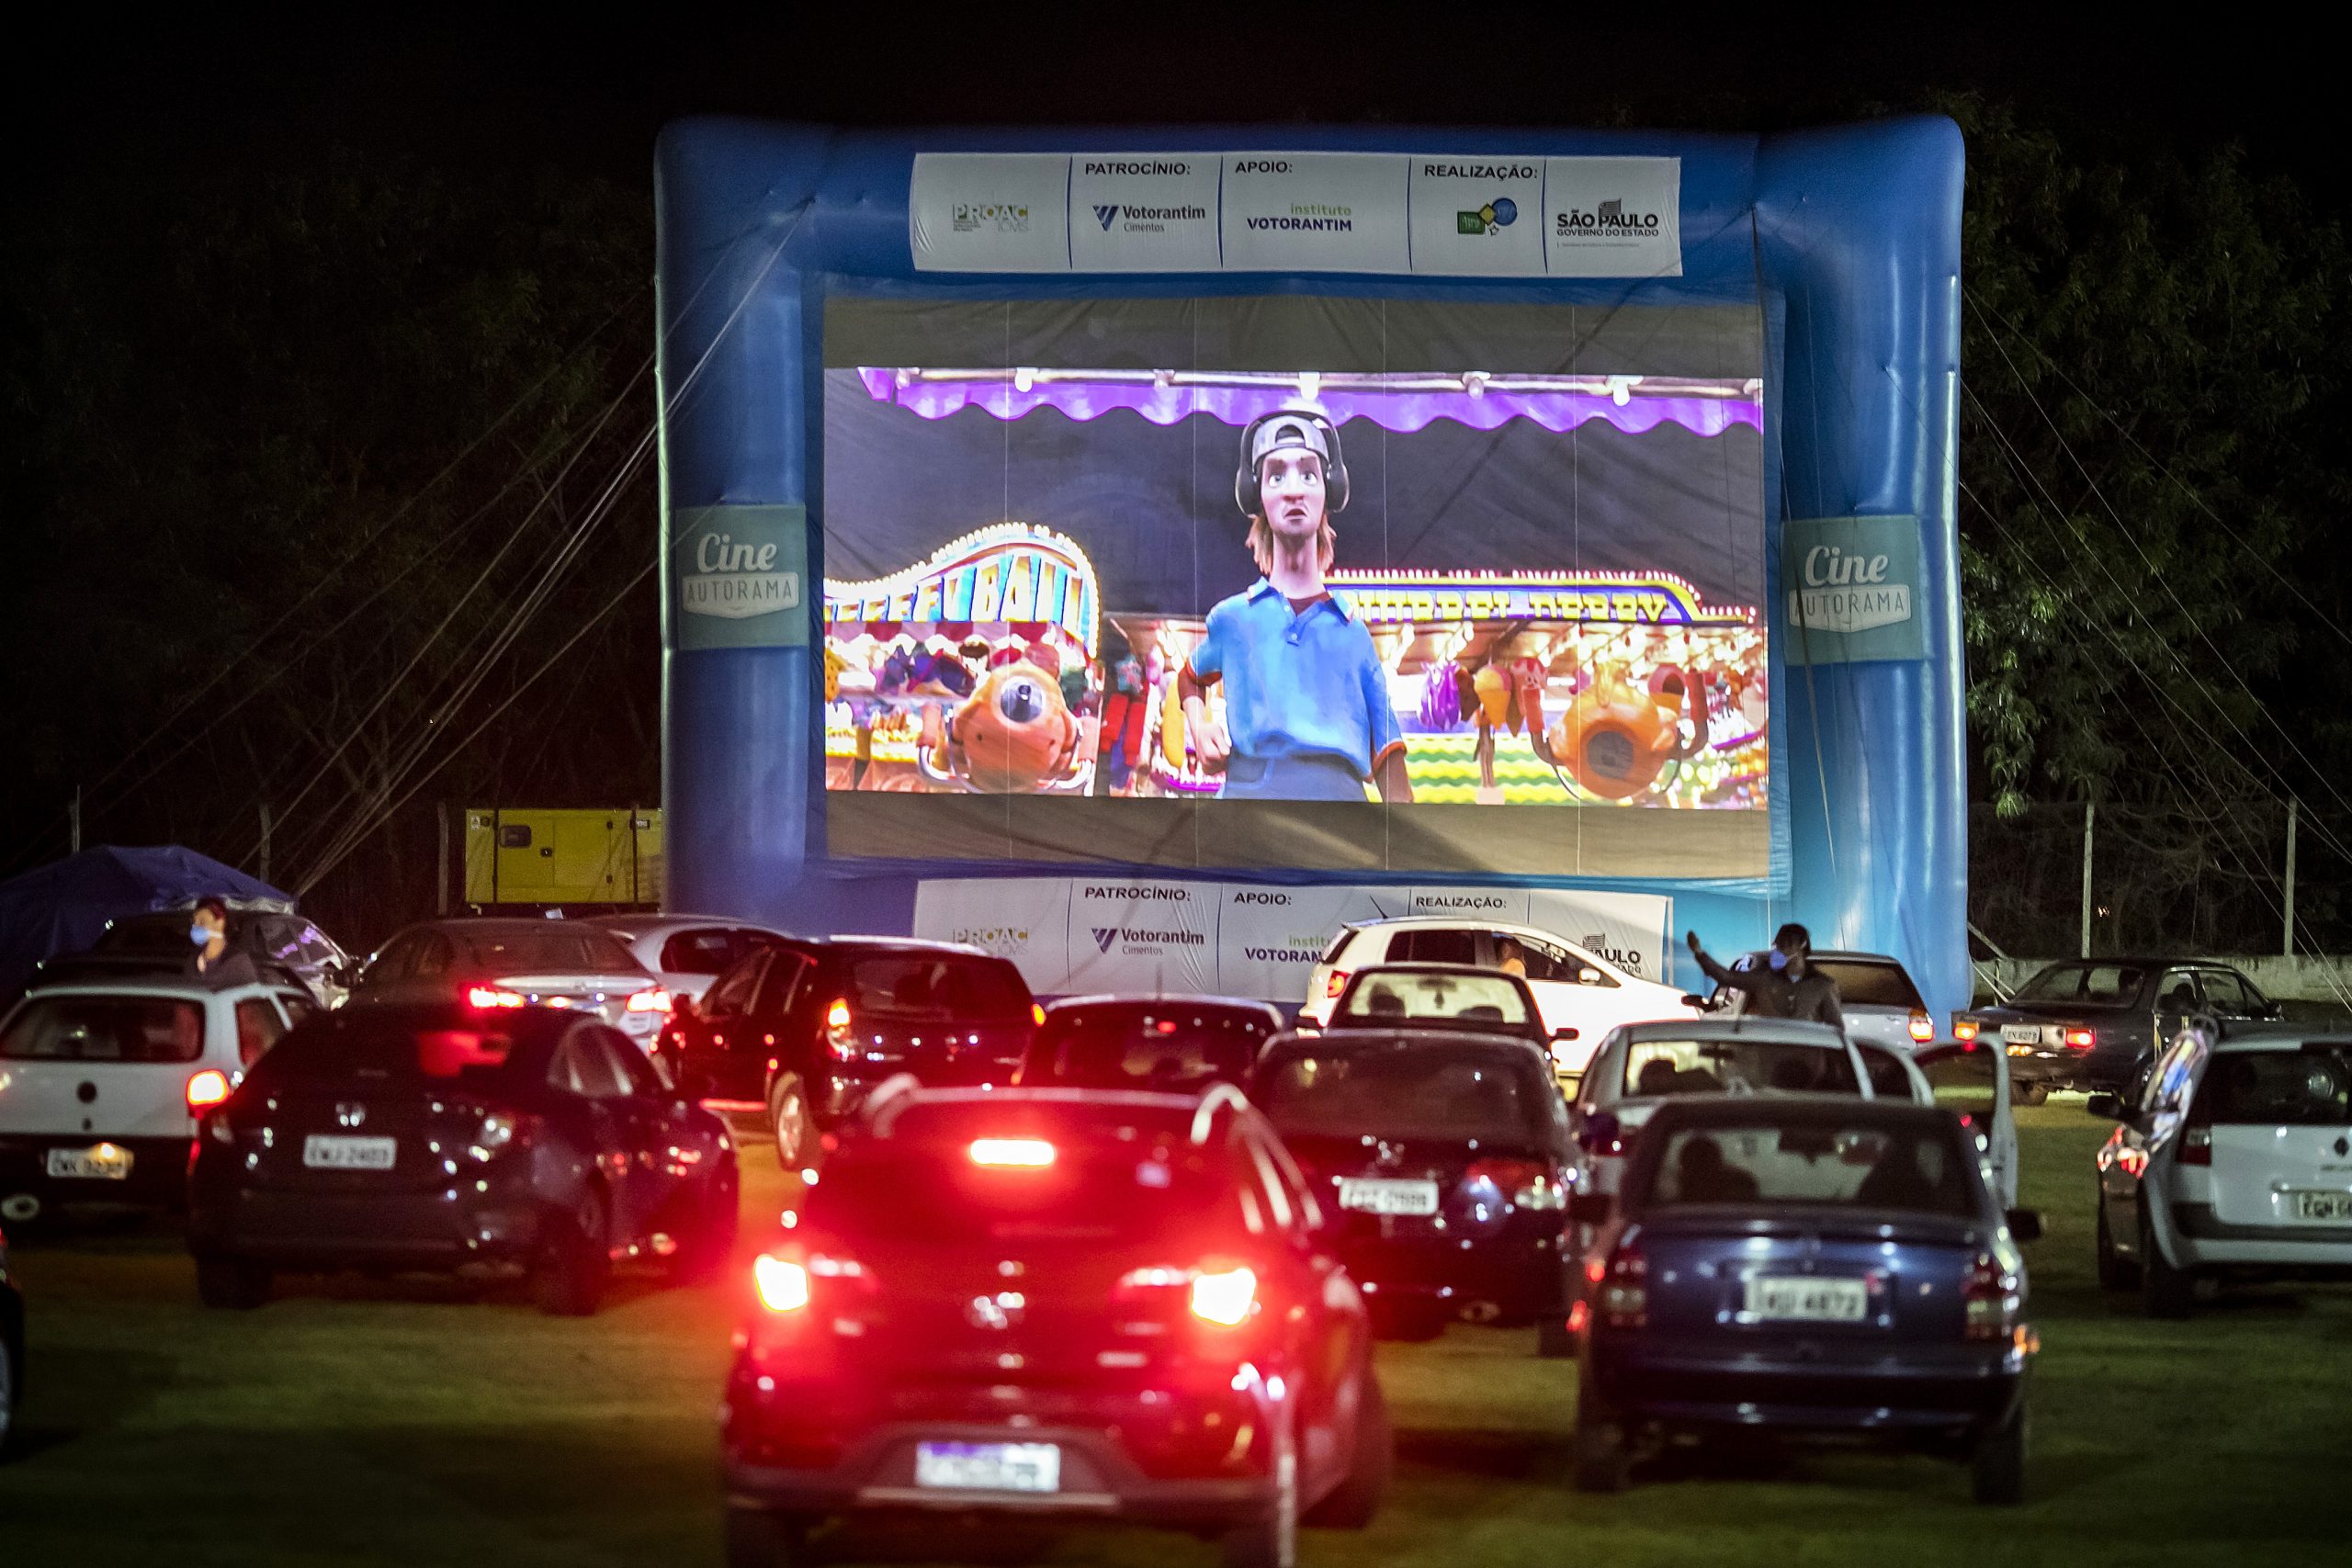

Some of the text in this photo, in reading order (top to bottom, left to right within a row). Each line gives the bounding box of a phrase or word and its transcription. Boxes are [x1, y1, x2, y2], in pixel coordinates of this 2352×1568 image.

[1085, 160, 1191, 175] PATROCÍNIO:
[1235, 161, 1293, 174] APOIO:
[1424, 164, 1538, 181] REALIZAÇÃO:
[1123, 205, 1206, 220] Votorantim
[1290, 201, 1351, 215] instituto
[1246, 217, 1352, 231] VOTORANTIM
[1557, 209, 1659, 229] SÃO PAULO
[1124, 222, 1165, 233] Cimentos
[1556, 229, 1659, 237] GOVERNO DO ESTADO
[696, 533, 778, 573] Cine
[1804, 545, 1888, 587] Cine
[688, 580, 793, 603] AUTORAMA
[1084, 885, 1191, 902] PATROCÍNIO:
[1235, 891, 1292, 906] APOIO:
[1416, 895, 1507, 909] REALIZAÇÃO:
[1121, 928, 1204, 944] Votorantim
[1123, 945, 1163, 956] Cimentos
